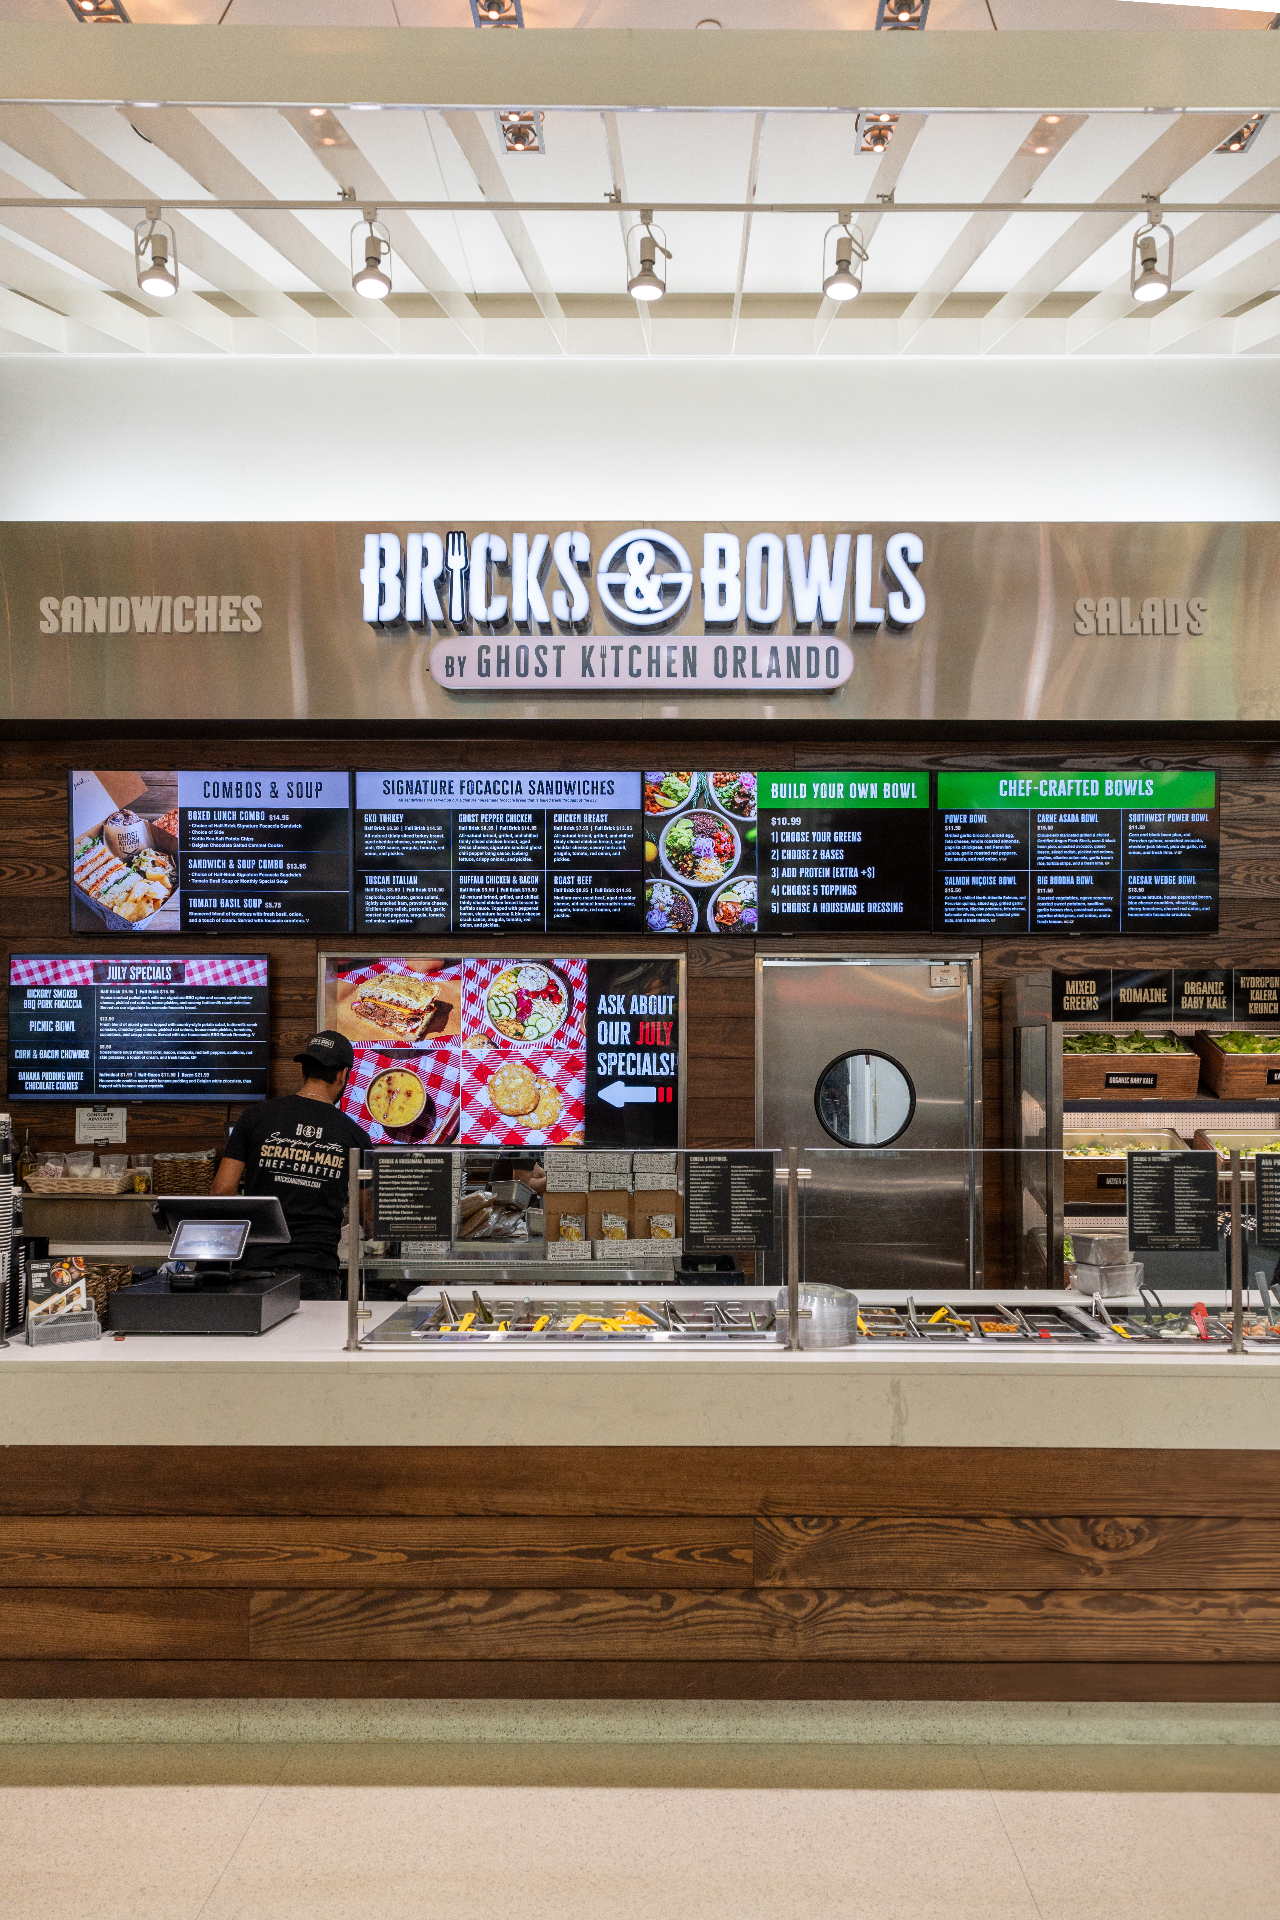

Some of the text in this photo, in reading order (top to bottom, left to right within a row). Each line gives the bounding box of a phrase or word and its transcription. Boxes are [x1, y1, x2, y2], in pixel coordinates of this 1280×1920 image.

[360, 531, 591, 623] BRICKS
[700, 532, 926, 623] BOWLS
[39, 595, 263, 634] SANDWICHES
[1074, 597, 1209, 636] SALADS
[445, 645, 840, 678] BY GHOST KITCHEN ORLANDO
[203, 781, 323, 799] COMBOS & SOUP
[382, 779, 615, 796] SIGNATURE FOCACCIA SANDWICHES
[771, 783, 918, 799] BUILD YOUR OWN BOWL
[999, 779, 1154, 796] CHEF-CRAFTED BOWLS
[187, 811, 211, 821] BOXED
[213, 811, 237, 821] LUNCH
[239, 811, 265, 821] COMBO
[364, 813, 404, 823] GKO TURKEY
[458, 813, 533, 823] GHOST PEPPER CHICKEN
[553, 813, 608, 823] CHICKEN BREAST
[770, 816, 802, 827] $10.99
[944, 814, 988, 823] POWER BOWL
[1037, 814, 1099, 823] CARNE ASADA BOWL
[1128, 813, 1209, 823] SOUTHWEST POWER BOWL
[771, 831, 862, 843] 1) CHOOSE YOUR GREENS
[771, 849, 844, 860] 2) CHOOSE 2 BASES
[188, 859, 227, 869] SANDWICH
[228, 859, 235, 869] &
[237, 859, 256, 869] SOUP
[258, 859, 284, 869] COMBO
[771, 867, 875, 878] 3) ADD PROTEIN (EXTRA +$)
[364, 875, 418, 885] TUSCAN ITALIAN
[459, 875, 539, 885] BUFFALO CHICKEN & BACON
[553, 875, 592, 885] ROAST BEEF
[944, 876, 970, 886] SALMON
[998, 876, 1017, 886] BOWL
[1037, 876, 1094, 885] BIG BUDDHA BOWL
[1128, 875, 1196, 885] CAESAR WEDGE BOWL
[771, 884, 857, 896] 4) CHOOSE 5 TOPPINGS
[188, 899, 217, 908] TOMATO
[220, 899, 241, 908] BASIL
[243, 899, 263, 908] SOUP
[771, 902, 904, 913] 5) CHOOSE A HOUSEMADE DRESSING
[106, 966, 172, 980] JULY SPECIALS
[1065, 980, 1096, 995] MIXED
[1184, 981, 1225, 995] ORGANIC
[26, 989, 78, 999] HICKORY SMOKED
[1119, 988, 1168, 1003] ROMAINE
[1250, 990, 1278, 1001] KALERA
[23, 999, 83, 1010] BBQ PORK FOCACCIA
[597, 994, 675, 1015] ASK ABOUT
[1063, 996, 1099, 1011] GREENS
[1181, 996, 1227, 1010] BABY KALE
[1248, 1002, 1279, 1015] KRUNCH
[29, 1020, 76, 1032] PICNIC BOWL
[597, 1020, 674, 1046] OUR JULY
[14, 1049, 31, 1060] CORN
[32, 1049, 38, 1060] &
[38, 1049, 59, 1060] BACON
[60, 1049, 90, 1060] CHOWDER
[597, 1052, 675, 1076] SPECIALS!
[18, 1071, 84, 1081] BANANA PUDDING WHITE
[1142, 1077, 1154, 1085] KALE
[24, 1081, 79, 1091] CHOCOLATE COOKIES
[260, 1144, 345, 1169] SCRATCH-MADE
[258, 1158, 342, 1179] CHEF-CRAFTED
